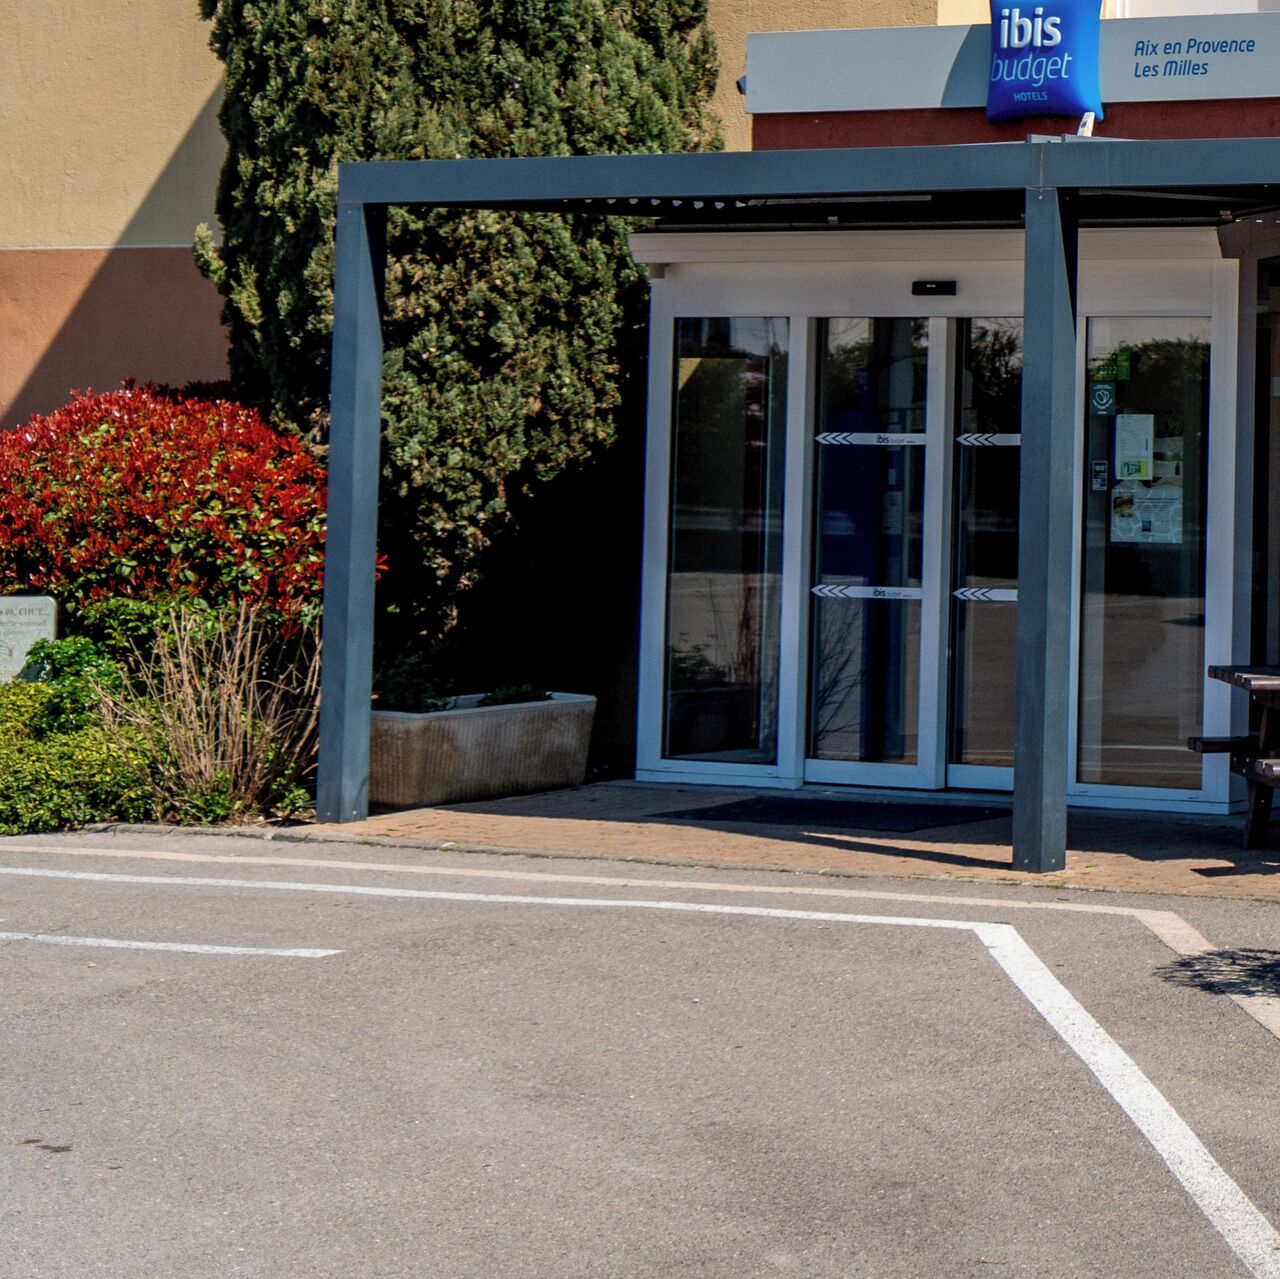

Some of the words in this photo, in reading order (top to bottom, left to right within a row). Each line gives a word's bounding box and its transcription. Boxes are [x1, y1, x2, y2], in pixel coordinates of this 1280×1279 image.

[999, 7, 1062, 49] ibis
[1134, 39, 1159, 57] Aix
[1163, 41, 1182, 55] en
[1186, 37, 1256, 55] Provence
[990, 50, 1073, 87] budget
[1134, 62, 1159, 78] Les
[1163, 59, 1209, 76] Milles
[1013, 91, 1049, 102] HOTELS
